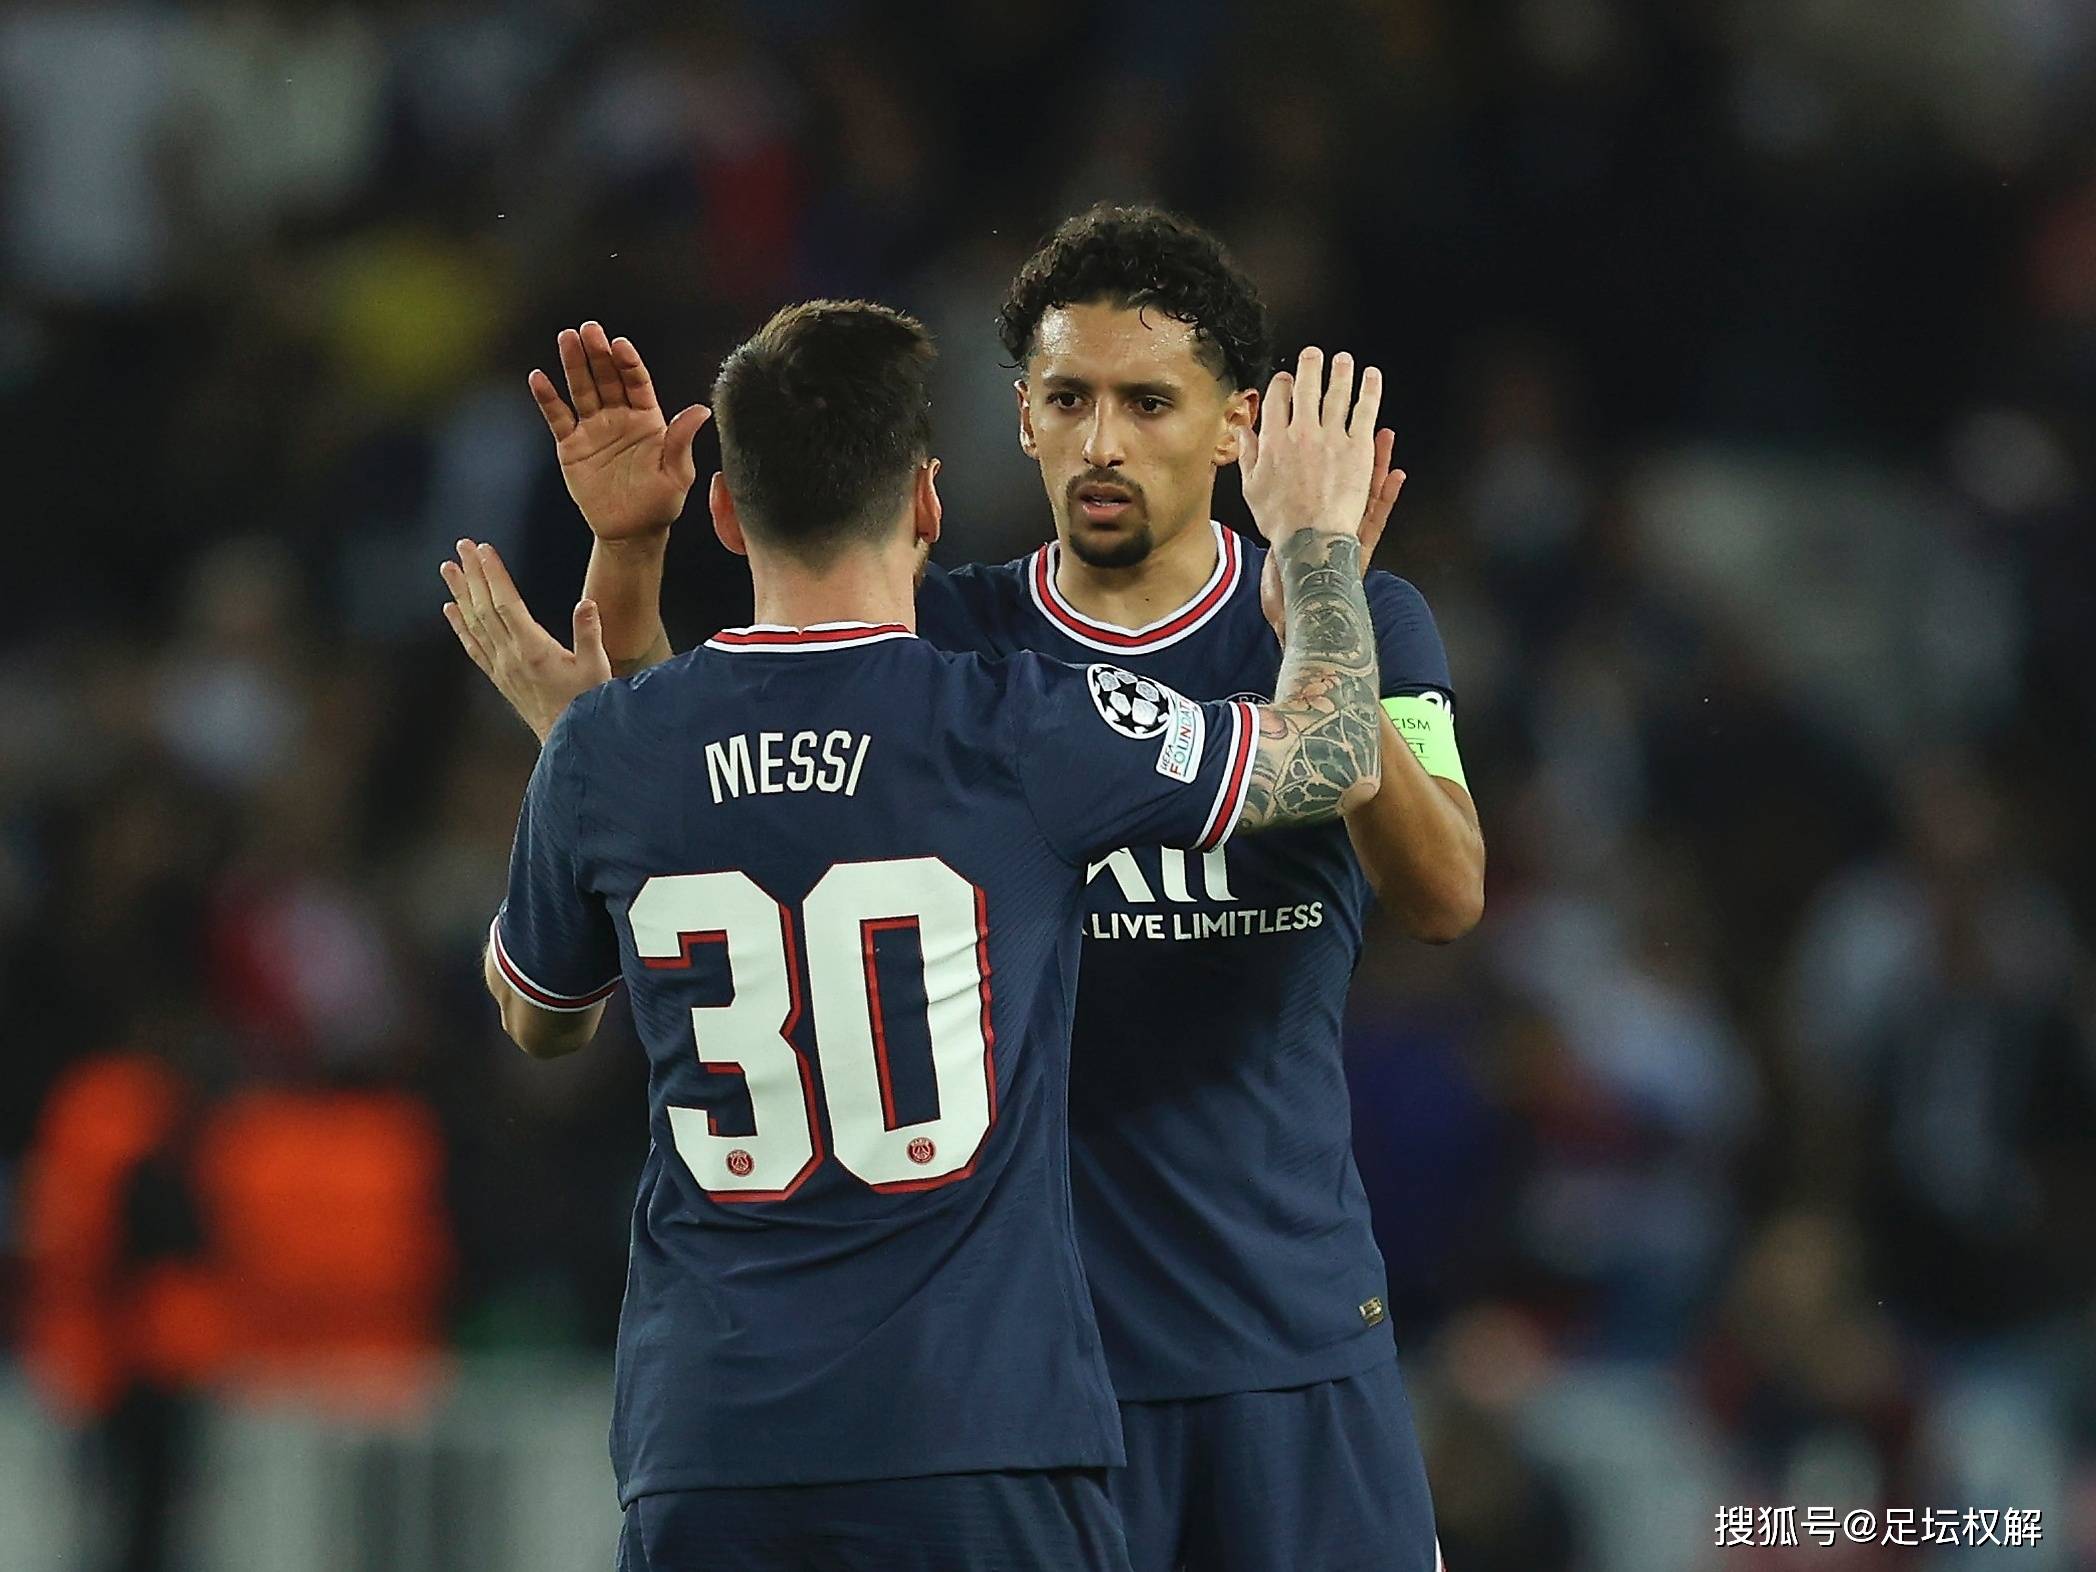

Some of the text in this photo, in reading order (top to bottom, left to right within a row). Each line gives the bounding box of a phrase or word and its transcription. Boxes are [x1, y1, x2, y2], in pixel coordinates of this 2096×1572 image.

[704, 729, 872, 805] MESSI
[1091, 901, 1324, 941] LIVE LIMITLESS
[628, 856, 998, 1204] 30
